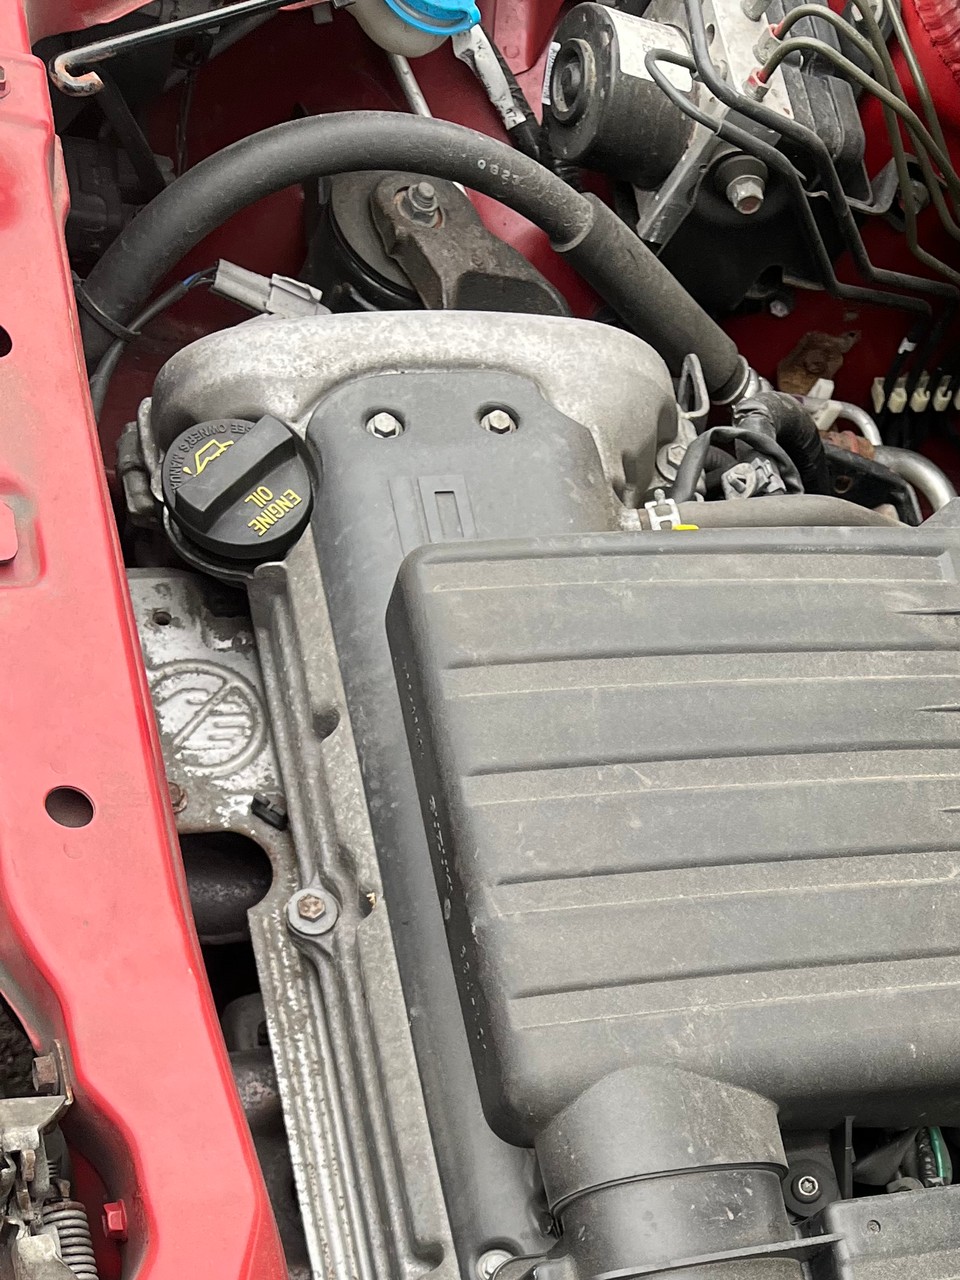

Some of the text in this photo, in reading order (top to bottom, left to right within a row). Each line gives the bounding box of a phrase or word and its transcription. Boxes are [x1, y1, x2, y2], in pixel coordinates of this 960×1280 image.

[178, 423, 227, 453] OWNER'S
[169, 452, 185, 493] MANUA
[244, 485, 274, 508] OIL
[247, 488, 302, 537] ENGINE
